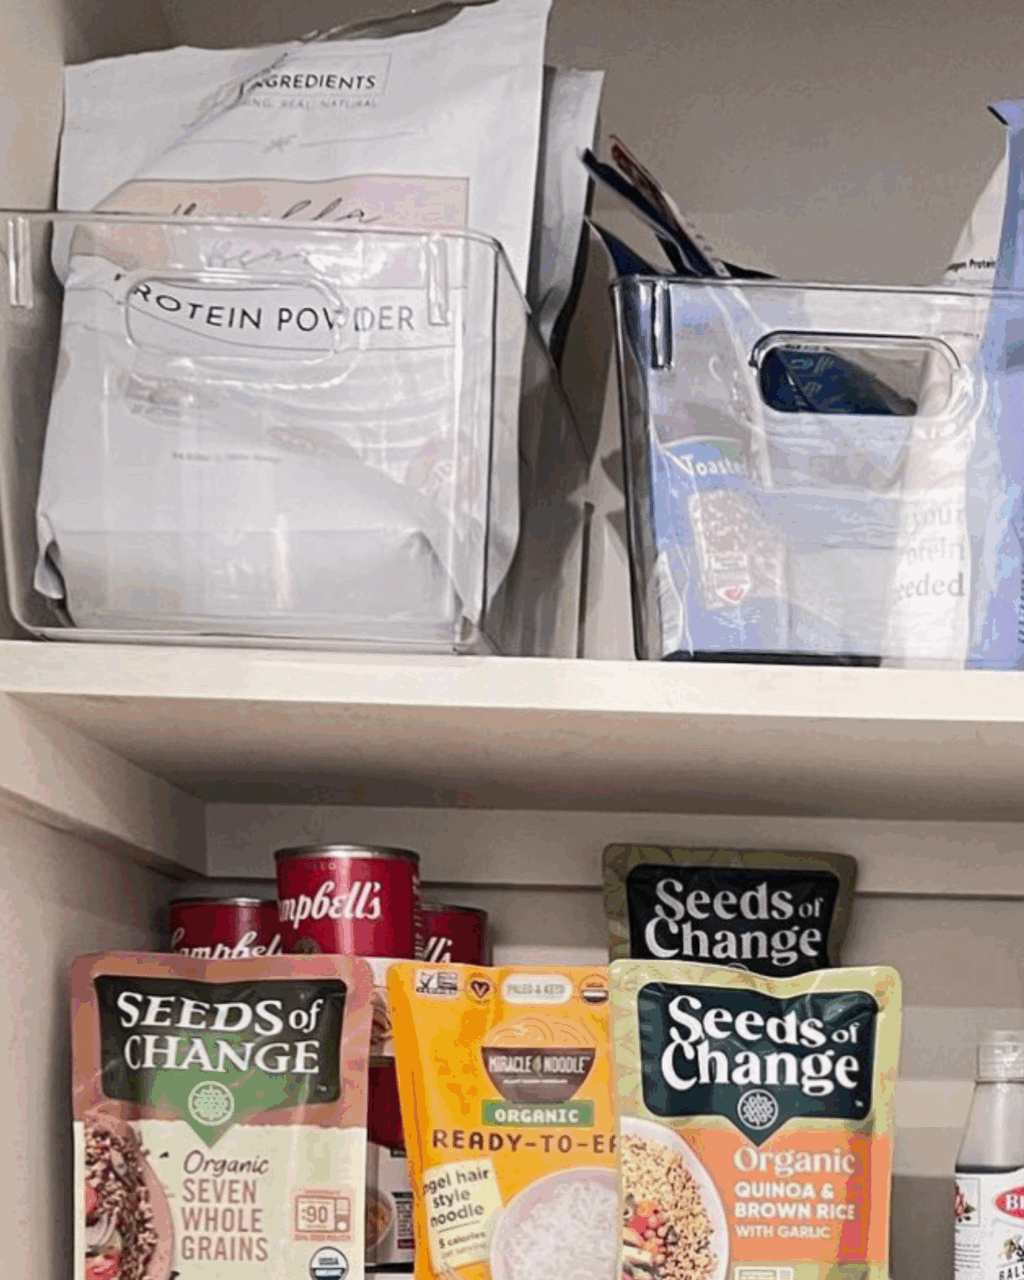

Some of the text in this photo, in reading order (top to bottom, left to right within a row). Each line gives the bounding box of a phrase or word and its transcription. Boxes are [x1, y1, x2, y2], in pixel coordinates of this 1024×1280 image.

[112, 276, 262, 331] ROTEIN
[279, 881, 382, 929] mpbell's
[654, 878, 825, 921] Seeds of
[170, 927, 284, 959] Campbel
[645, 915, 823, 967] Change
[116, 991, 325, 1038] SEEDS of
[667, 994, 861, 1049] Seeds of
[124, 1034, 320, 1075] CHANGE
[488, 1055, 588, 1074] MIRACLE NOODLE
[661, 1038, 861, 1097] Change
[494, 1107, 580, 1124] ORGANIC
[183, 1149, 270, 1178] Organic
[455, 1167, 489, 1184] hair
[732, 1147, 856, 1178] Organic
[182, 1177, 258, 1205] SEVEN
[432, 1188, 471, 1209] style
[734, 1180, 834, 1201] QUINOA &
[181, 1206, 264, 1234] WHOLE
[430, 1203, 485, 1228] noodle
[734, 1202, 856, 1221] BROWN RICE
[735, 1225, 831, 1240] WITH GARLIC
[181, 1235, 270, 1262] GRAINS
